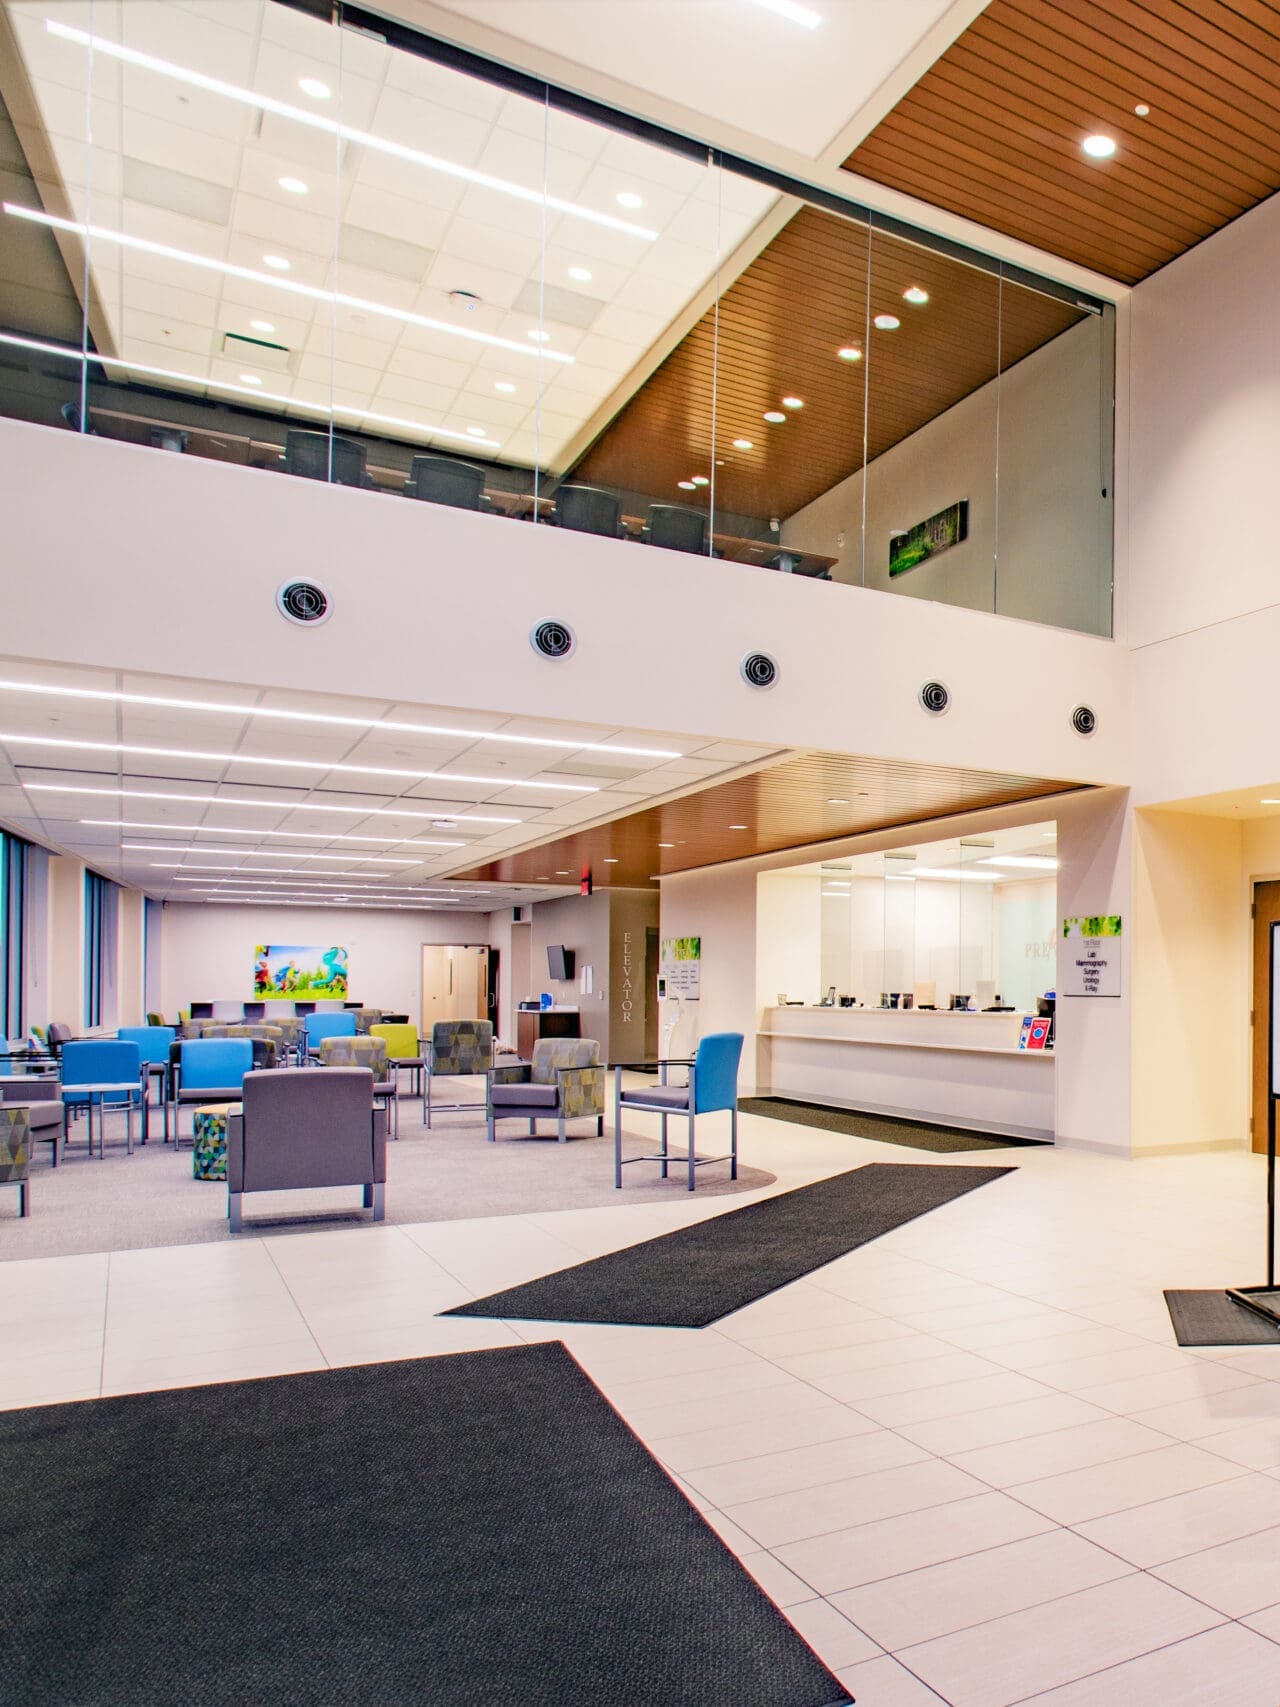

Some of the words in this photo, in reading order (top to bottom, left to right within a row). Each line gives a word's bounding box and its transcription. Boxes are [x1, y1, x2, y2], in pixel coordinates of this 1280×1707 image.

[1076, 960, 1107, 968] Mammography
[1083, 968, 1099, 976] Surgery
[621, 932, 633, 1022] ELEVATOR
